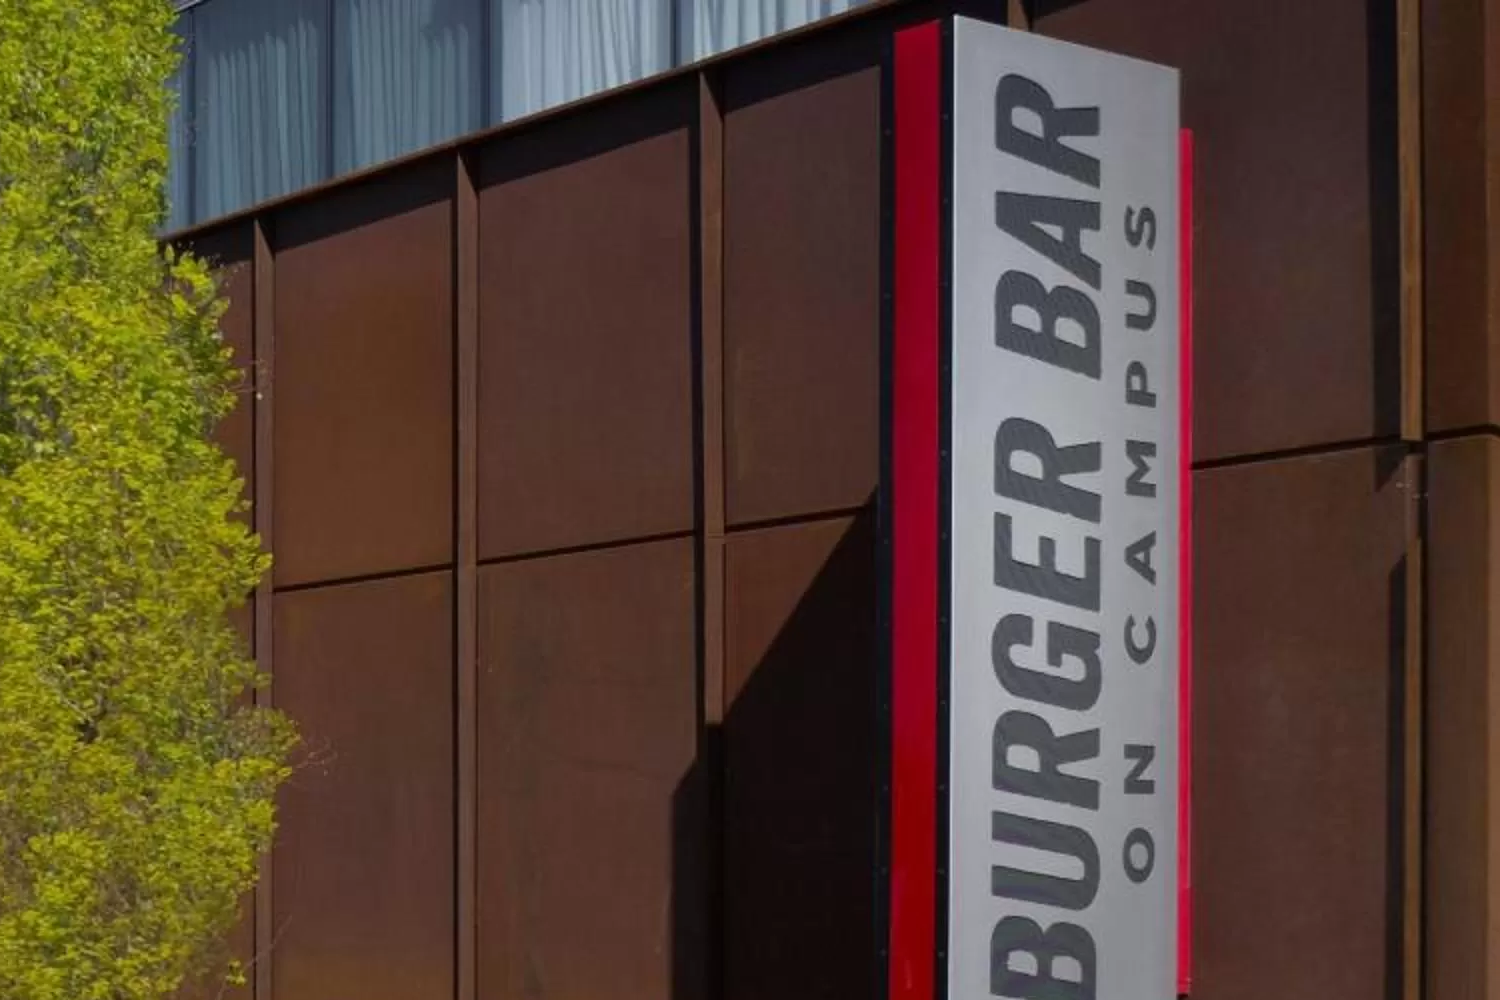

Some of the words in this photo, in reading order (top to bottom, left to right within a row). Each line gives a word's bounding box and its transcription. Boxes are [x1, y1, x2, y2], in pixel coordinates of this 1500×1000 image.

[994, 72, 1103, 381] BAR
[1123, 204, 1158, 666] CAMPUS
[1121, 743, 1158, 885] ON
